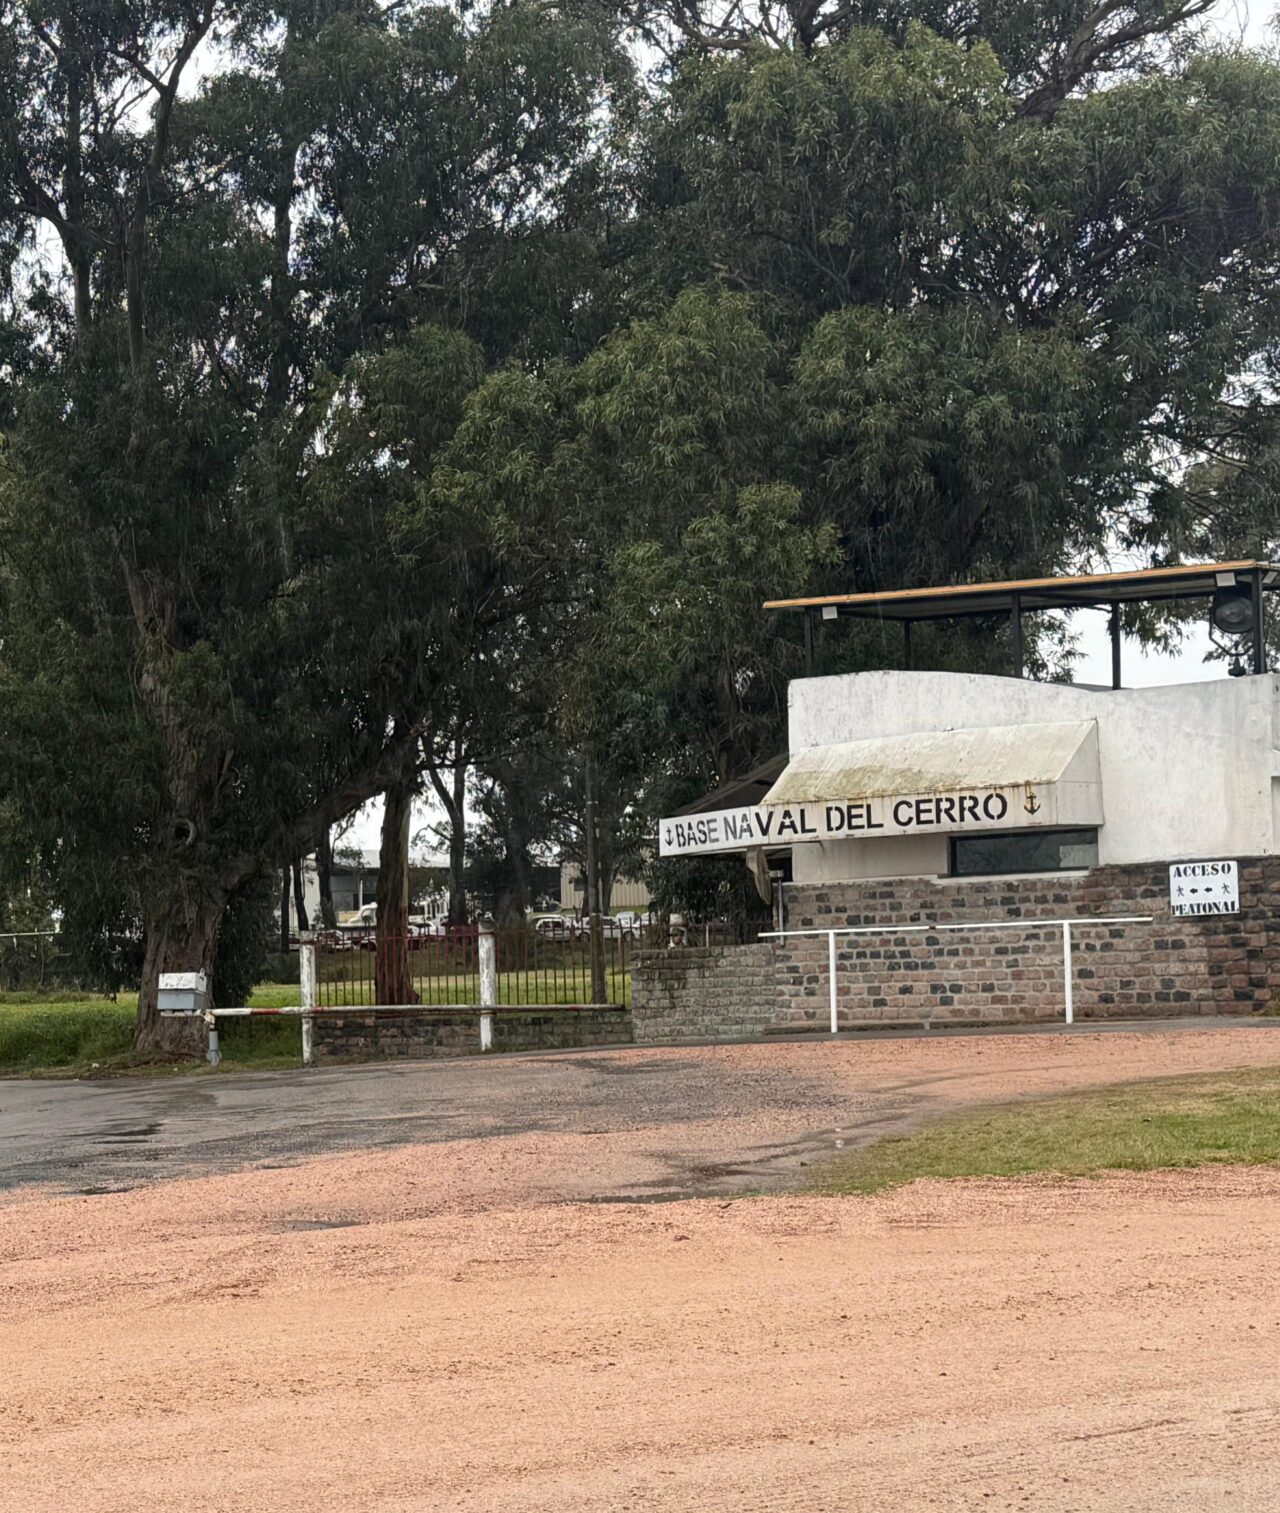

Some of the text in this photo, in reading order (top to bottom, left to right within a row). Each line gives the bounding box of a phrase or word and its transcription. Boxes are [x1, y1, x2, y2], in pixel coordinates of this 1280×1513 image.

[676, 793, 1008, 847] BASE NAVAL DEL CERRO
[1174, 863, 1231, 877] ACCESO
[1172, 901, 1239, 915] PEATONAL
